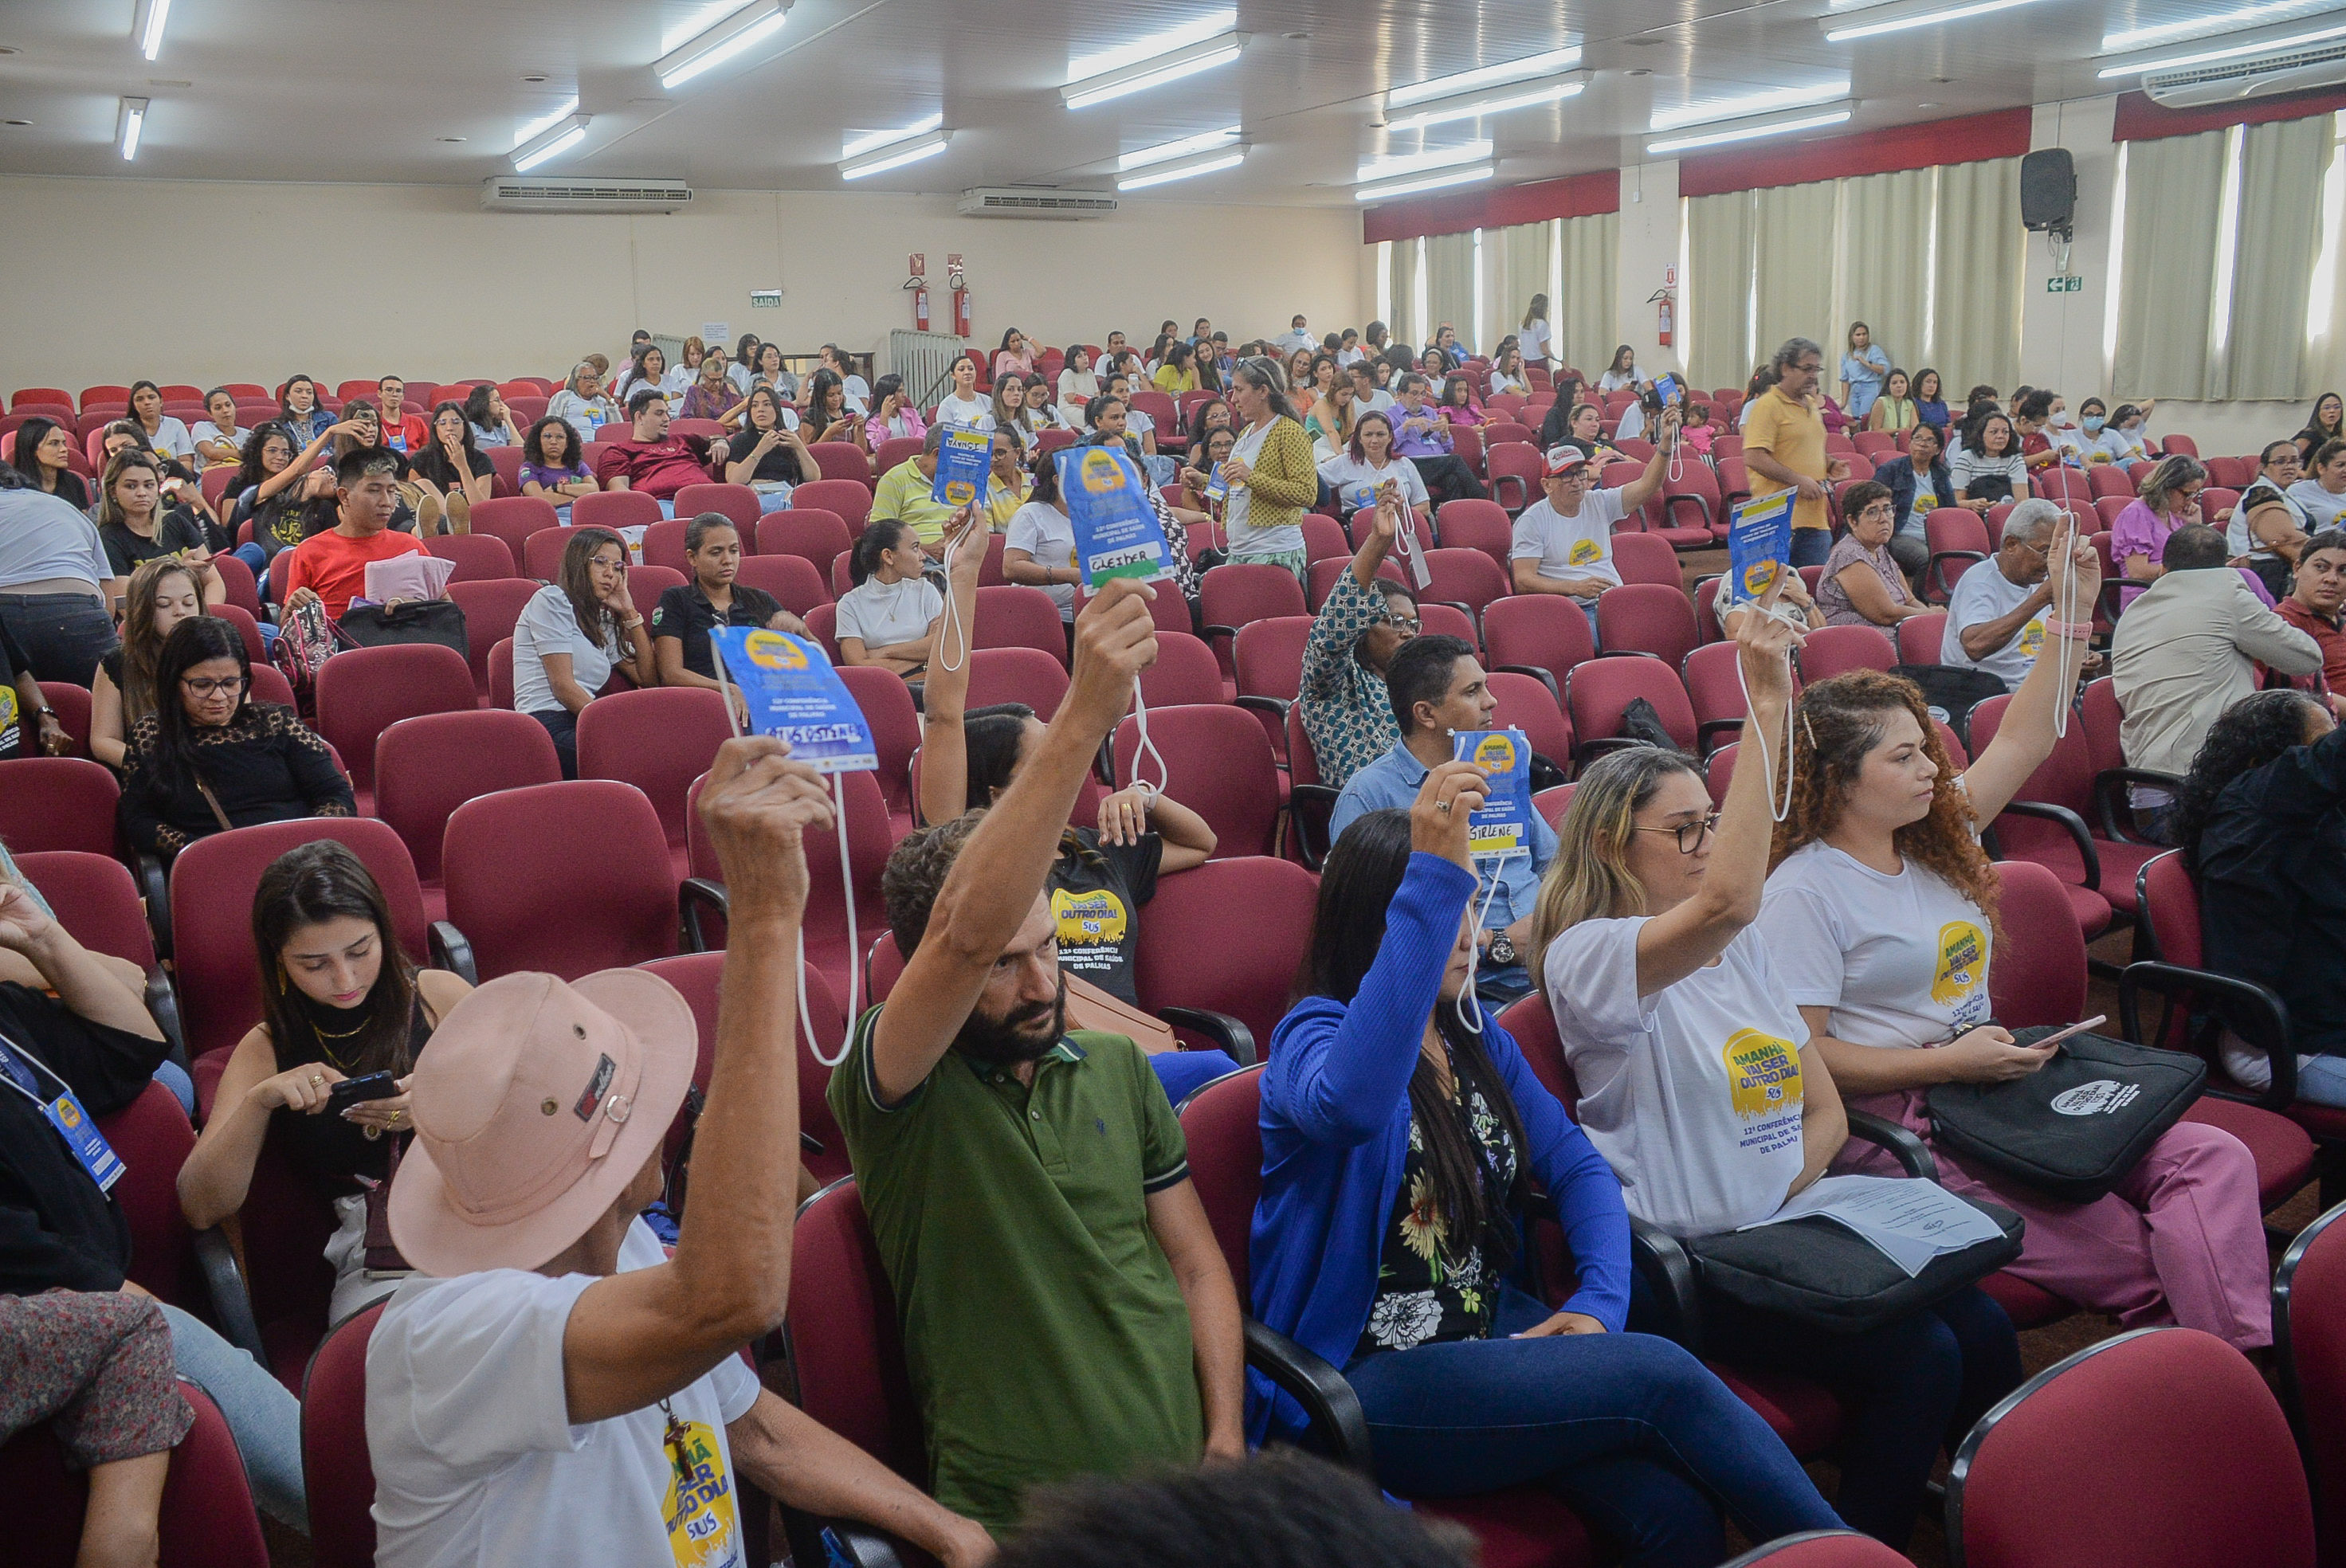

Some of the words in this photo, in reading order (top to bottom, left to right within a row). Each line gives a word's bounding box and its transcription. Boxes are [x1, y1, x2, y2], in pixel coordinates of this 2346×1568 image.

[752, 296, 779, 308] SAÍDA
[1469, 823, 1512, 841] SIRLENE
[1061, 909, 1096, 919] OUTRO
[1097, 908, 1118, 919] DIA!
[1083, 921, 1100, 932] SUS
[1962, 944, 1976, 958] SER
[1085, 962, 1112, 970] PALMAS
[1954, 971, 1970, 983] SUS
[1732, 1041, 1787, 1066] AMANHÃ
[1741, 1063, 1762, 1076] VAI
[1760, 1053, 1789, 1072] SER
[1740, 1071, 1780, 1089] OUTRO
[1780, 1064, 1799, 1080] DIA!
[1766, 1086, 1783, 1099] SUS
[1744, 1125, 1756, 1135] 12ª
[1740, 1133, 1778, 1148] MUNICIPAL
[1778, 1128, 1790, 1138] DE
[1760, 1145, 1771, 1154] DE
[687, 1511, 717, 1539] SUS
